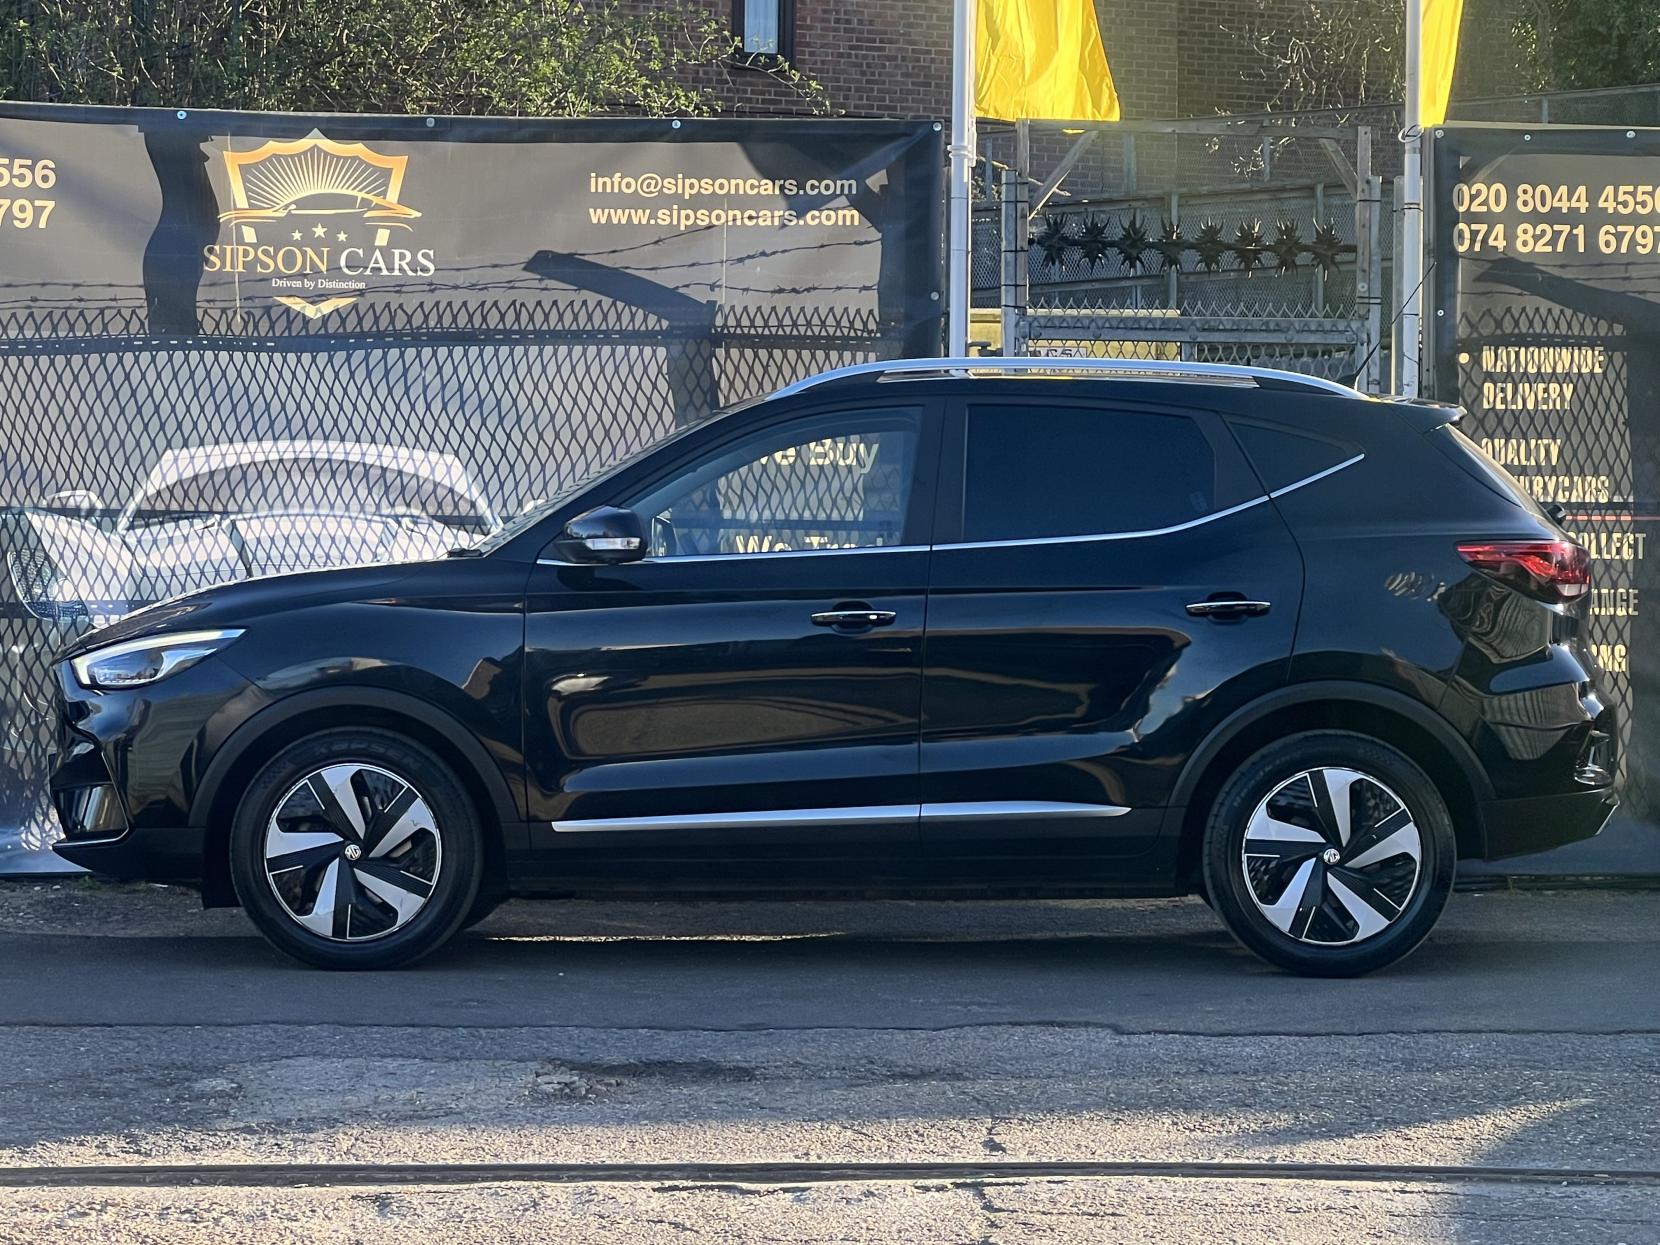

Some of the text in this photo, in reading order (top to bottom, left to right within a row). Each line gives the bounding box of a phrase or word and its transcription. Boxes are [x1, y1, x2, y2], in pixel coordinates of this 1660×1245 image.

[589, 172, 857, 199] info@sipsoncars.com
[1452, 182, 1660, 215] 020 8044 455
[588, 204, 860, 230] www.sipsoncars.com
[1452, 222, 1507, 253] 074
[1515, 222, 1586, 253] 8271
[203, 244, 436, 277] SIPSON CARS
[272, 278, 366, 290] Driven by Distinction
[1482, 345, 1605, 374] NATIONWIDE
[1482, 382, 1574, 410] DELIVERY
[809, 438, 880, 474] Buy
